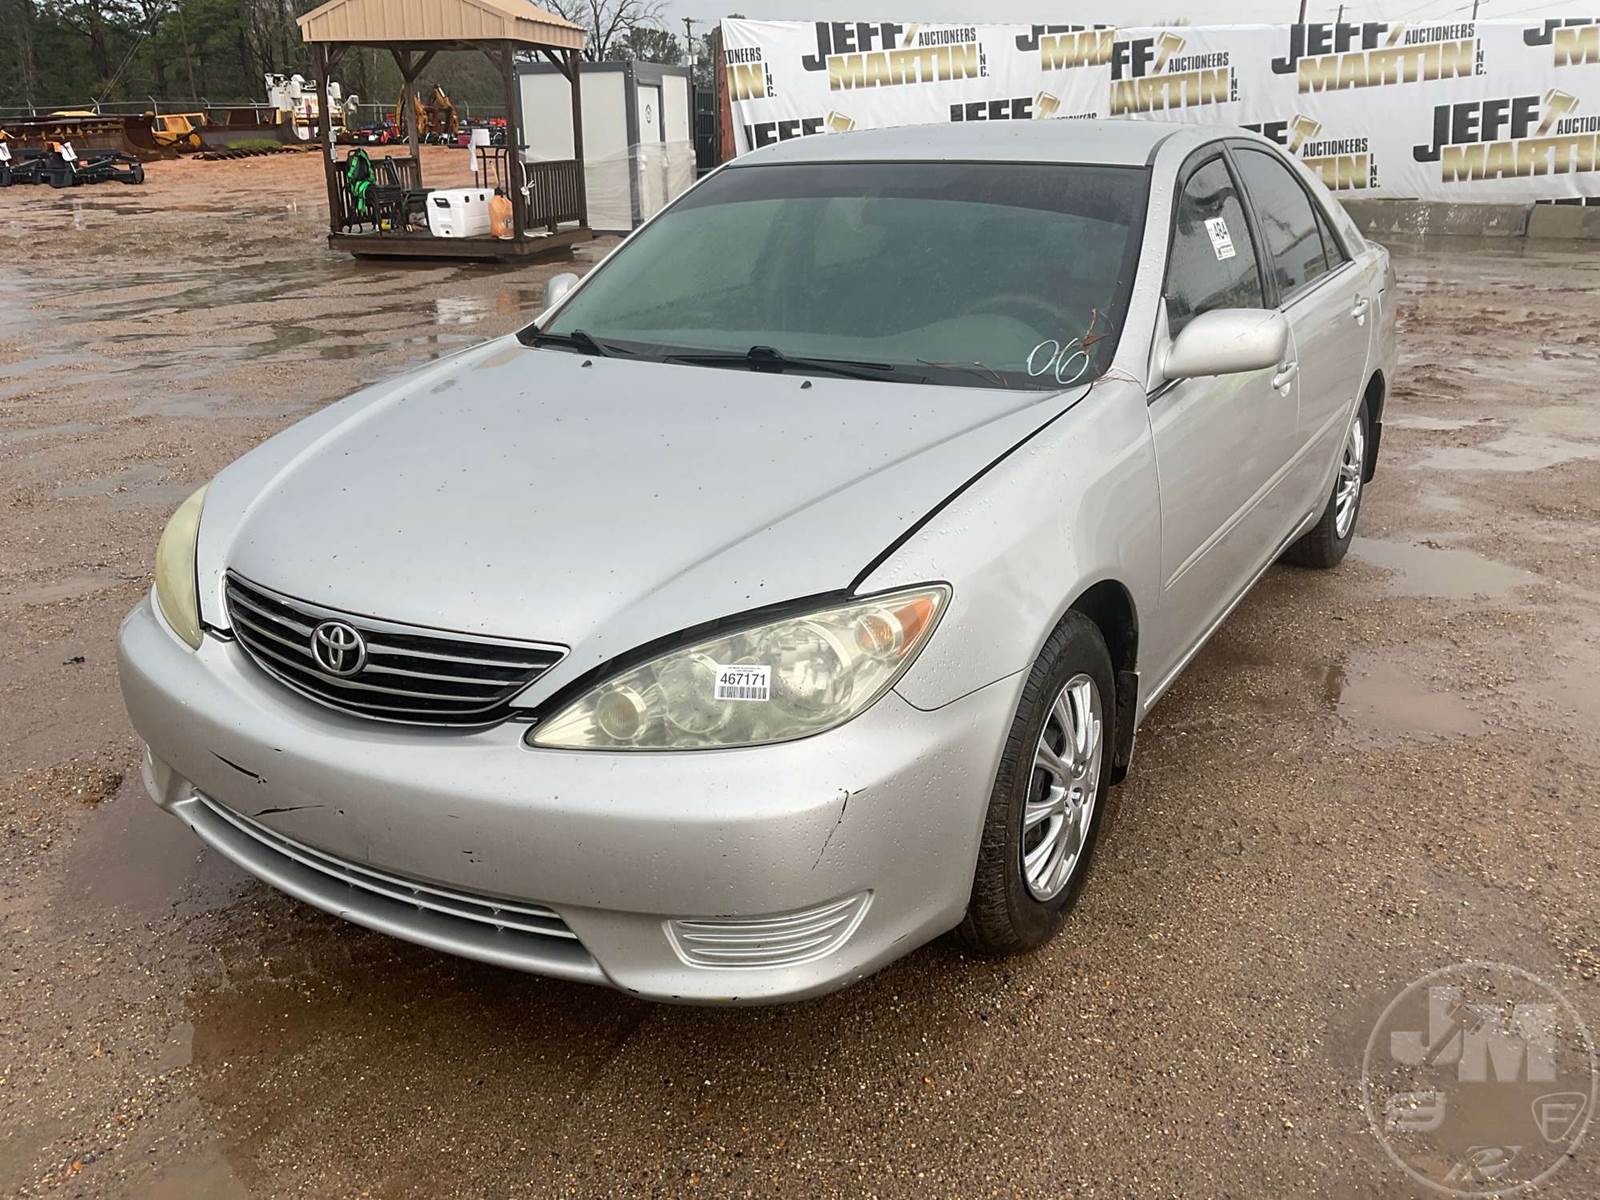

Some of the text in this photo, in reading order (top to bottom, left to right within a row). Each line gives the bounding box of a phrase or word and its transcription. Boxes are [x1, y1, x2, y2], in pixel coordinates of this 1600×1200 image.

[918, 27, 976, 47] AUCTIONEERS
[1404, 23, 1475, 45] AUCTIONEERS
[827, 43, 978, 91] MARTIN
[1168, 51, 1230, 73] AUCTIONEERS
[1298, 39, 1474, 94] MARTIN
[1413, 95, 1541, 163] JEFF
[1303, 137, 1368, 157] AUCTIONEERS
[1026, 337, 1090, 385] 06
[720, 672, 766, 686] 467171
